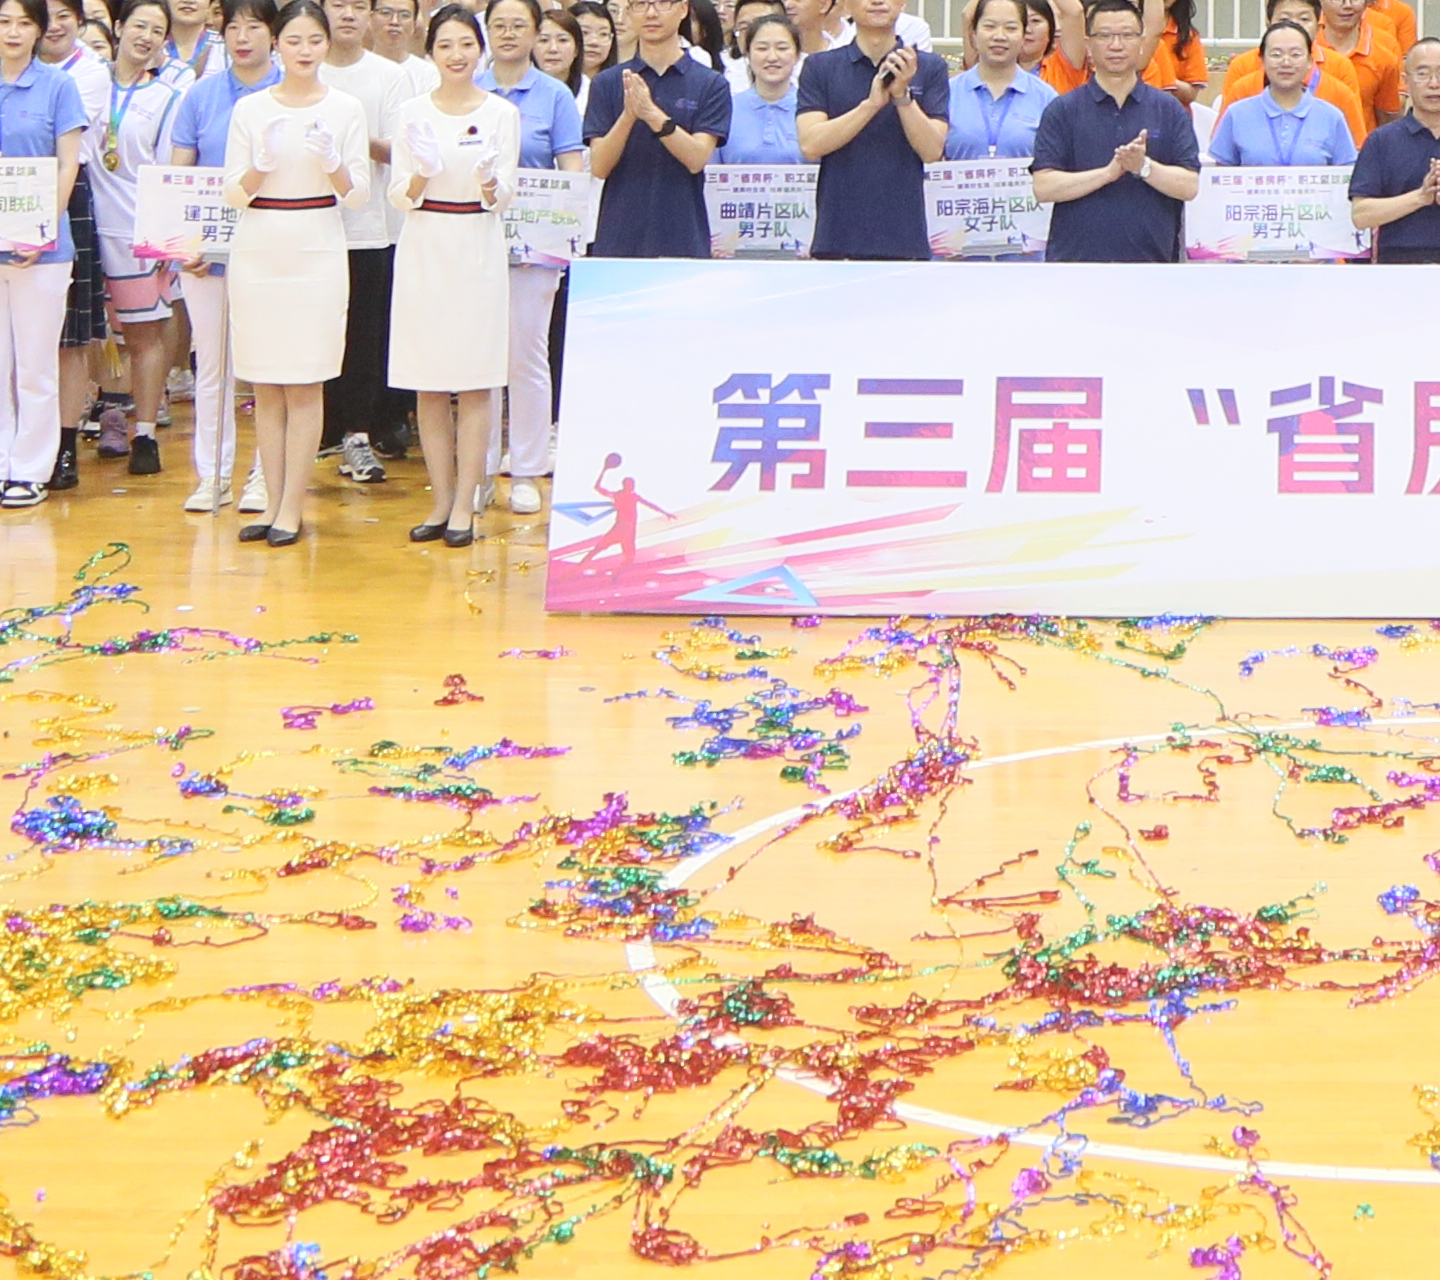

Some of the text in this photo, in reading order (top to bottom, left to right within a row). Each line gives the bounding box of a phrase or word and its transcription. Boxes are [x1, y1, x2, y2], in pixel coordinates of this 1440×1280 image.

[719, 201, 810, 221] 曲靖片区队
[936, 197, 1044, 217] 阳宗海片区队
[1225, 203, 1333, 223] 阳宗海片区队
[737, 221, 792, 239] 男子队
[963, 214, 1017, 233] 女子队
[1251, 221, 1305, 240] 男子队
